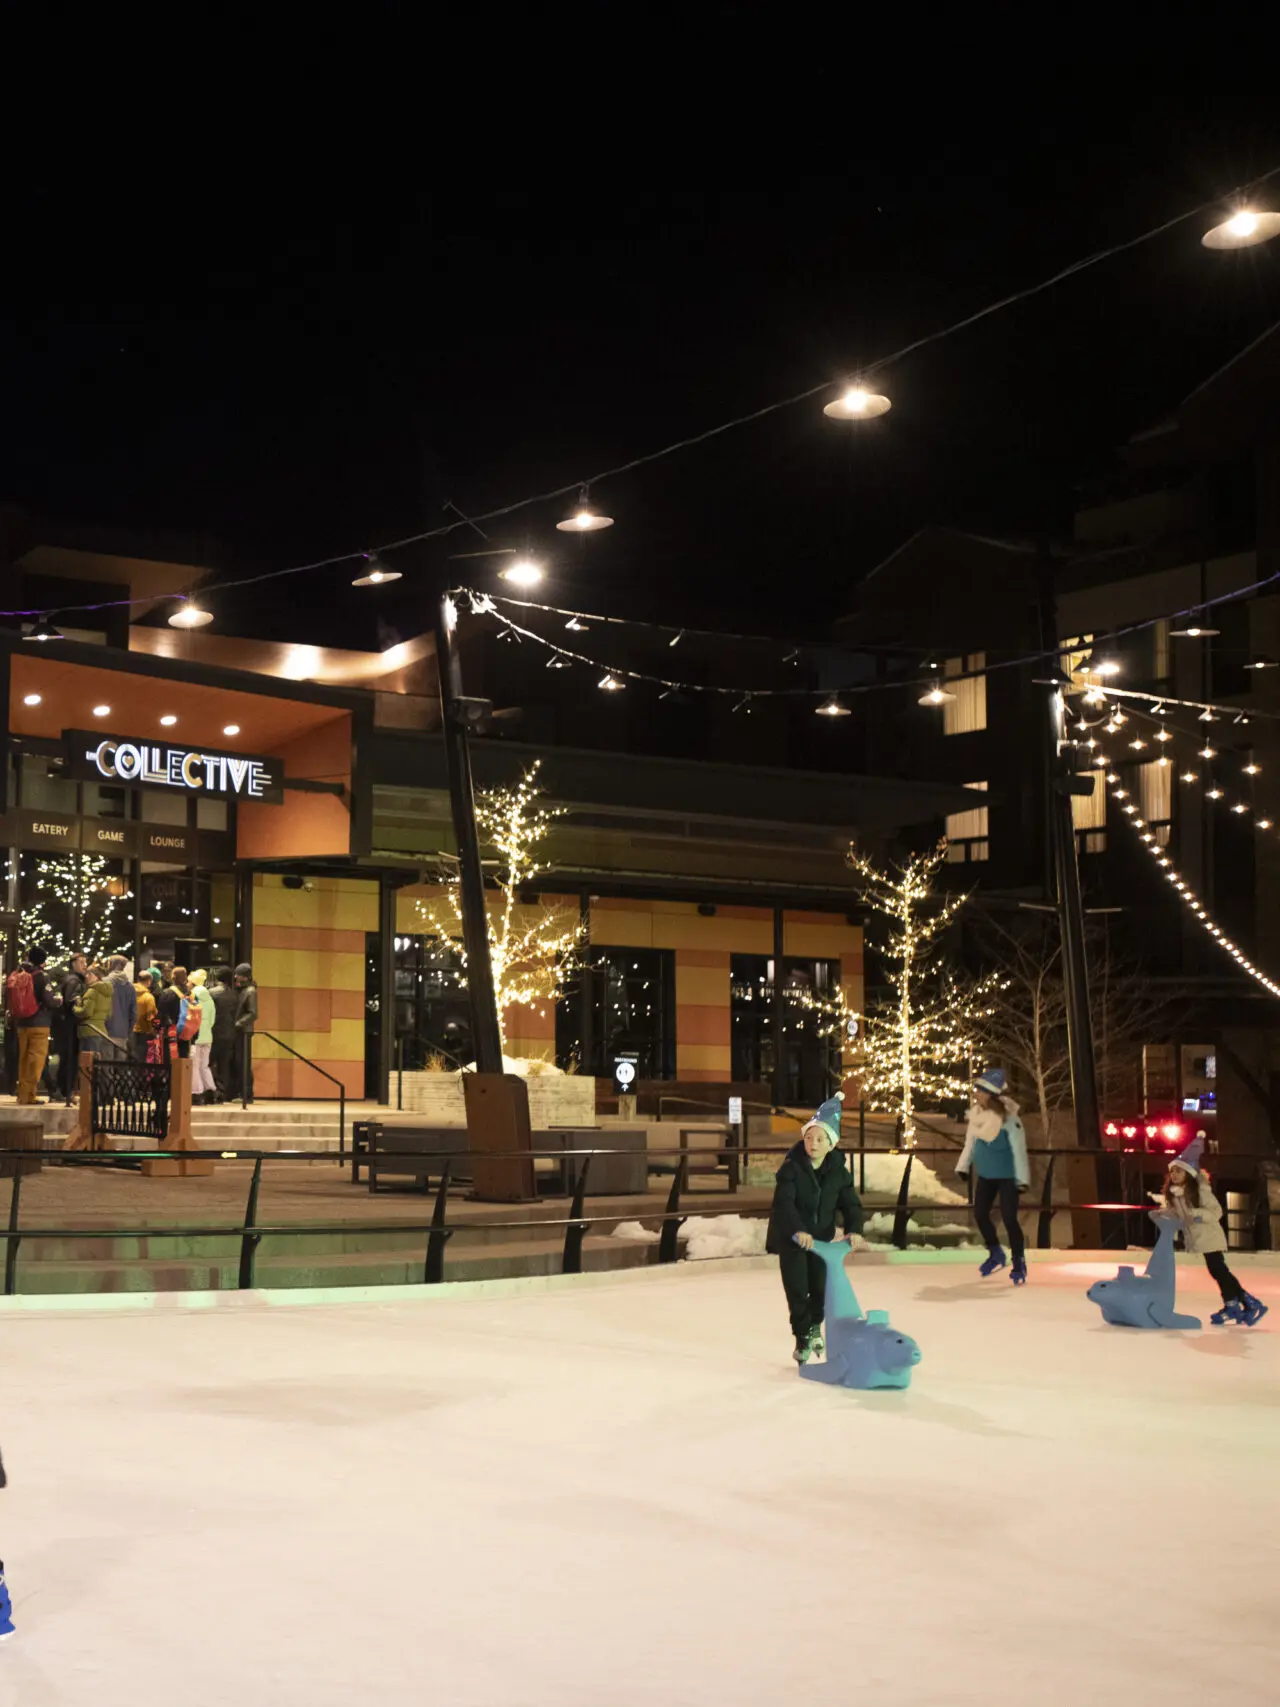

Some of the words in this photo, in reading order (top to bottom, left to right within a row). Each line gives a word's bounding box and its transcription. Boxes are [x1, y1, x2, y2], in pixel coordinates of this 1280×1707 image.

[95, 740, 272, 796] COLLECTIVE
[32, 822, 69, 836] EATERY
[97, 830, 125, 842] GAME
[150, 835, 186, 849] LOUNGE
